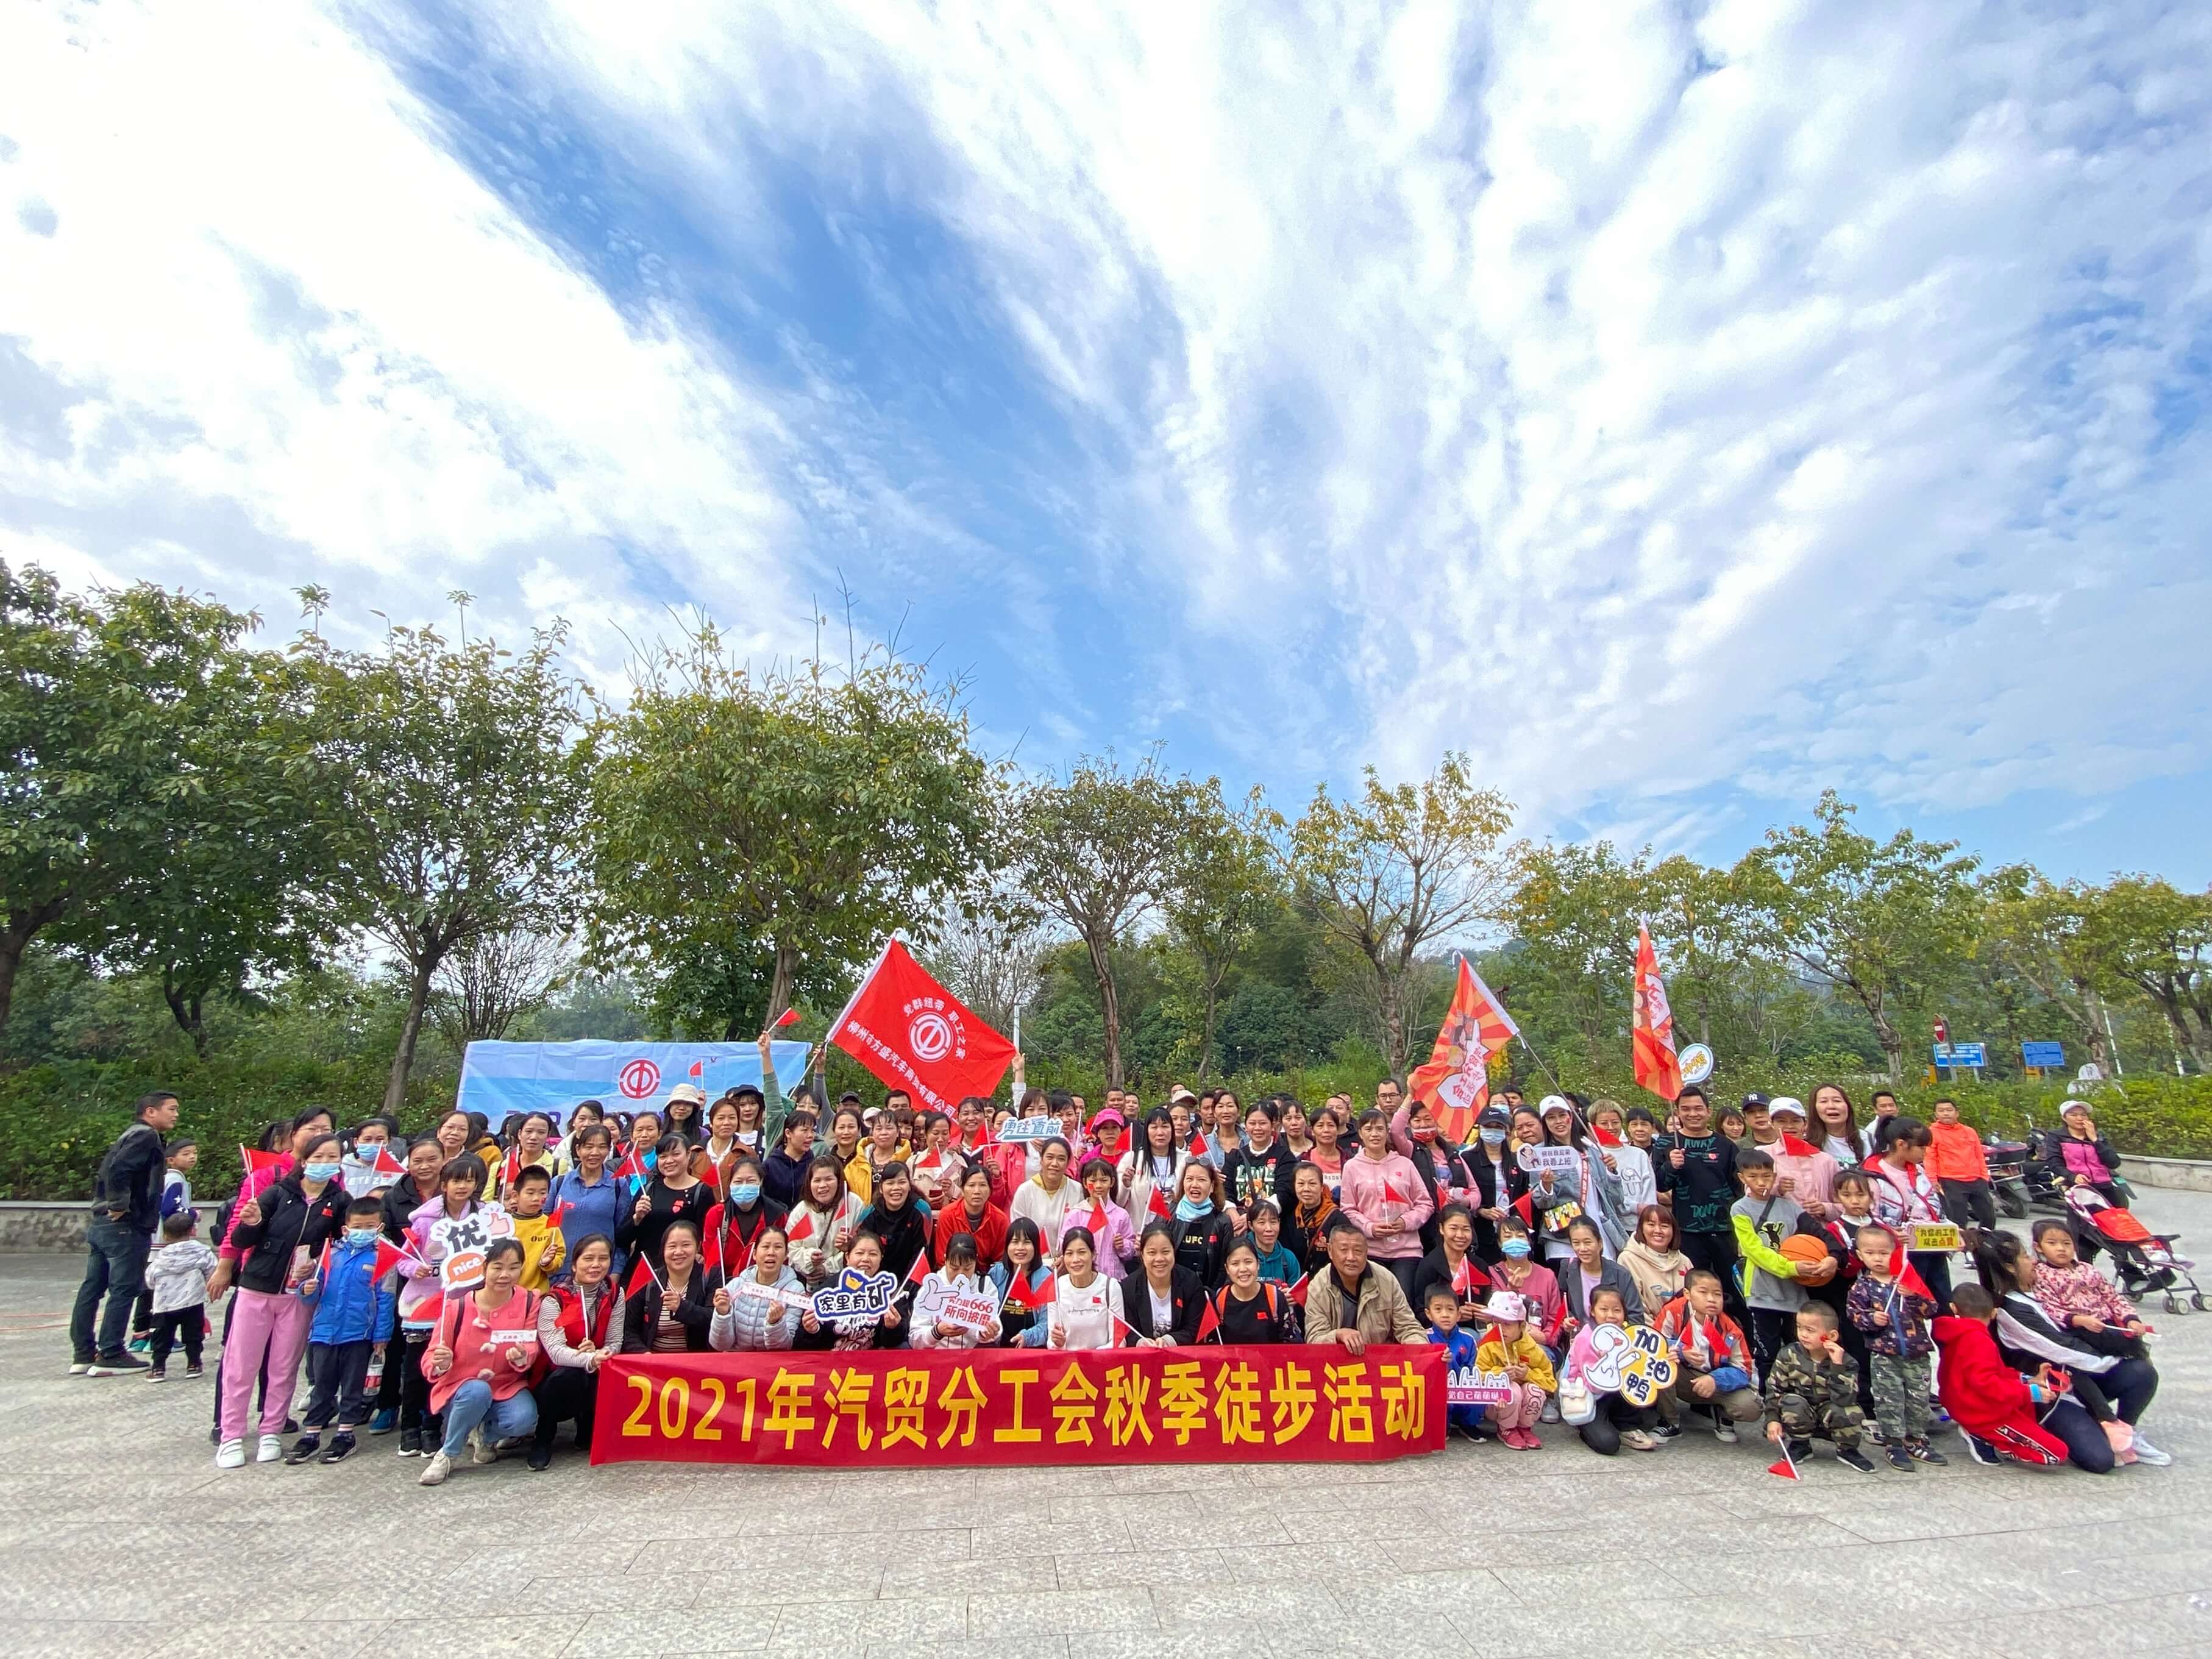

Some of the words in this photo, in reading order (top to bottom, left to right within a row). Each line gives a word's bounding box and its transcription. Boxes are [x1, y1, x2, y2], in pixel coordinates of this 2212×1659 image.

[846, 1019, 959, 1125] 柳州市方盛汽车商贸有限公司
[998, 1119, 1061, 1138] 勇往直前
[452, 1256, 482, 1276] nice
[819, 1279, 890, 1312] 家里有矿
[622, 1361, 1426, 1450] 2021年汽贸分工会秋季徒步活动
